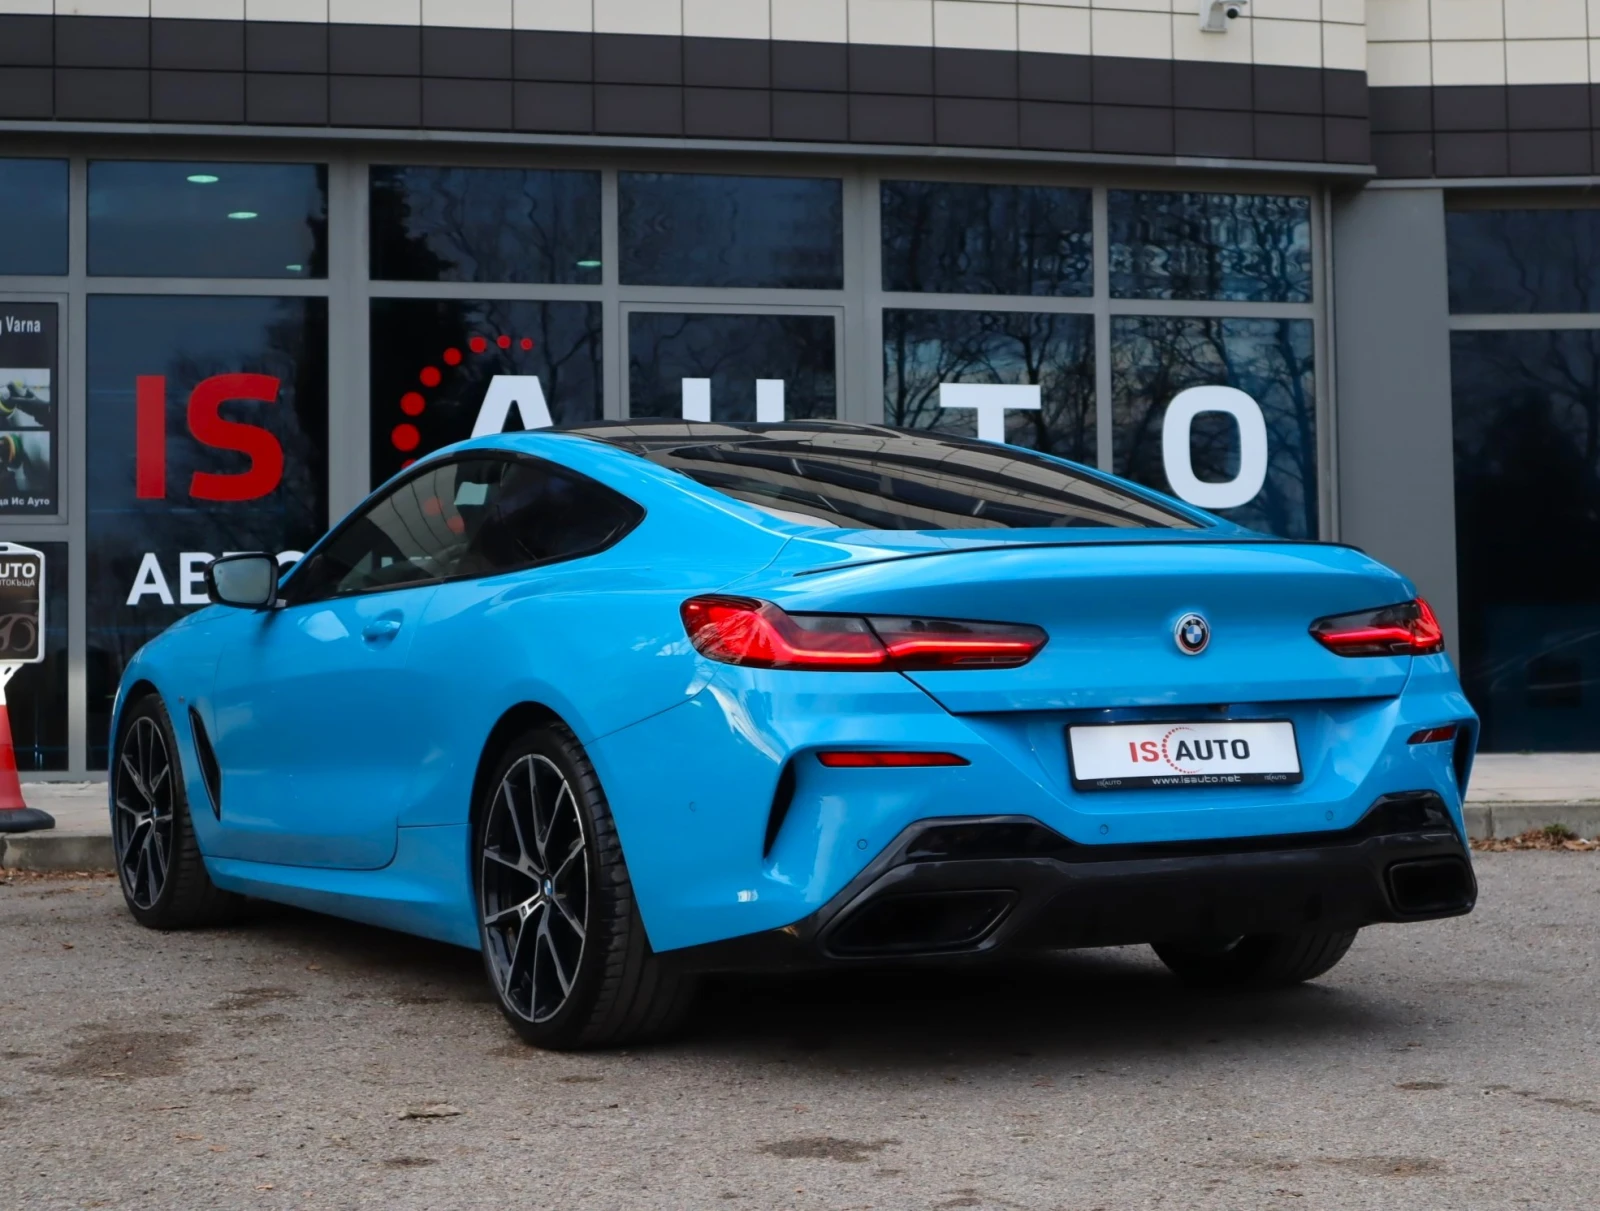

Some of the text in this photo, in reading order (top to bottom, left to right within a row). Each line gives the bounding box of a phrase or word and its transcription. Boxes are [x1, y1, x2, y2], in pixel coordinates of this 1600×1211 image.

[5, 315, 41, 333] Varna
[136, 373, 284, 501] IS
[11, 496, 25, 506] Ис
[27, 496, 50, 508] Ауто
[1129, 738, 1250, 763] IS AUTO
[1151, 774, 1242, 785] www.isauto.net
